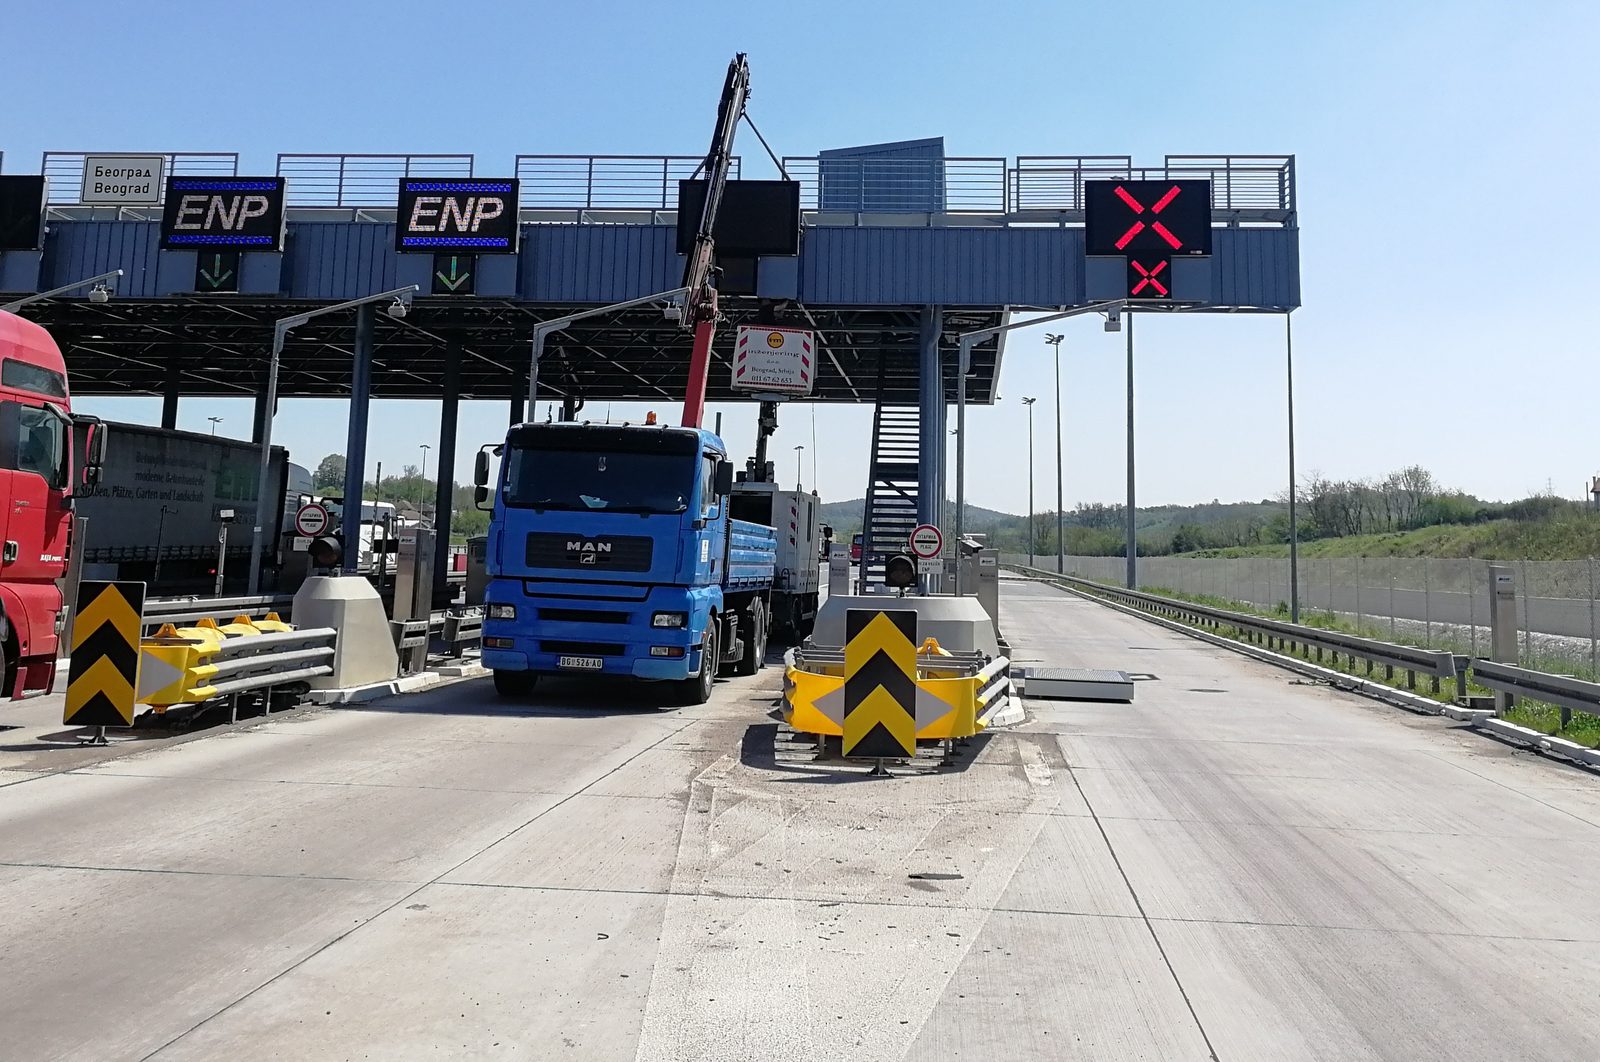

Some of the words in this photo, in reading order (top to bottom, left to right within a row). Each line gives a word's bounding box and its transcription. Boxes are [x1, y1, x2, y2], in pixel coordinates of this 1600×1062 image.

[95, 166, 151, 180] Београд
[94, 183, 150, 197] Beograd
[174, 195, 269, 230] ENP
[408, 197, 504, 232] ENP
[566, 541, 612, 552] MAN
[561, 657, 571, 666] BG
